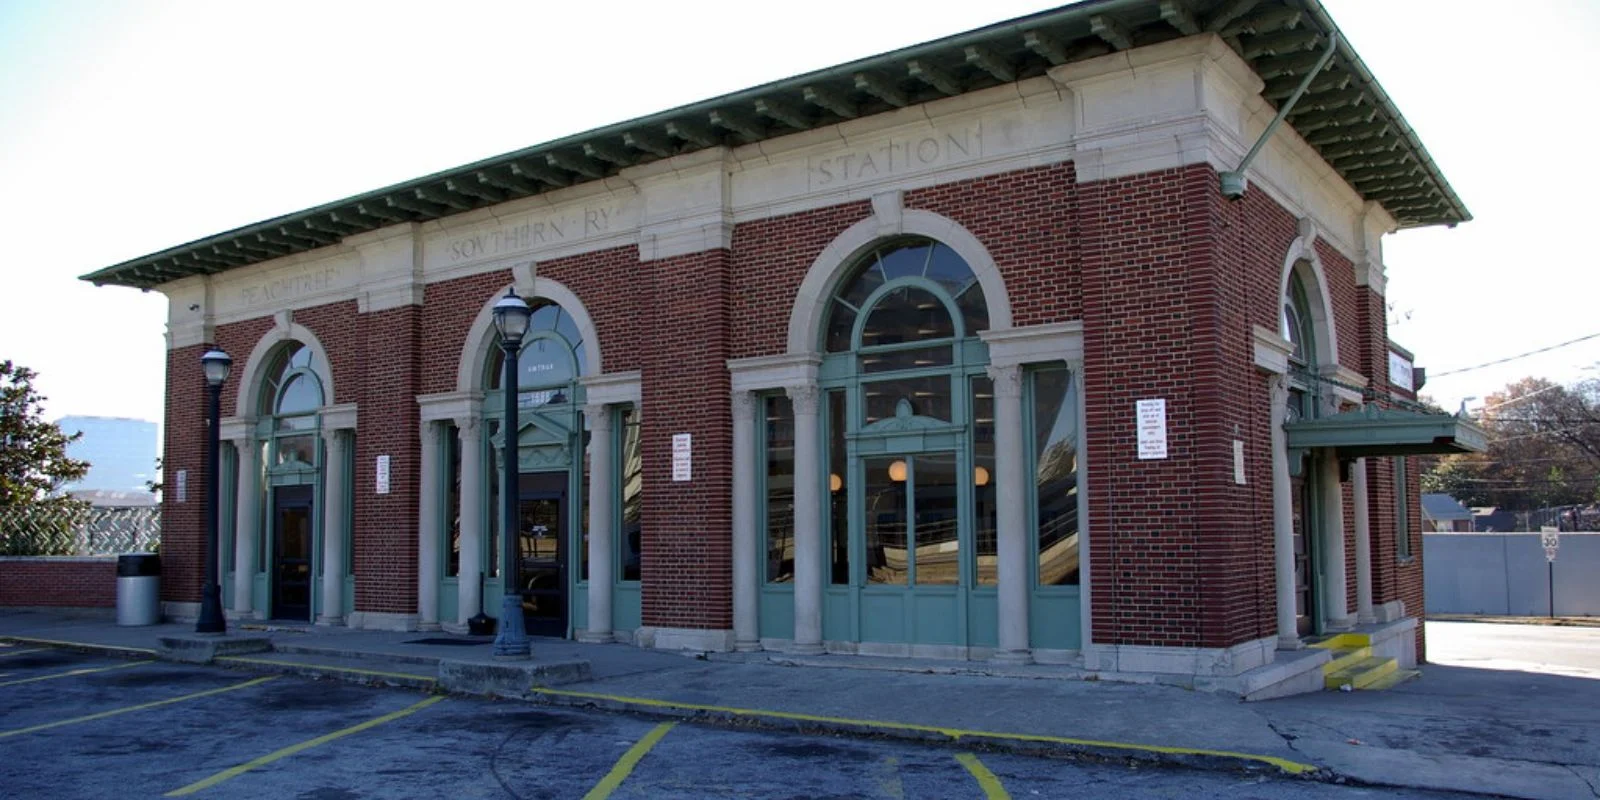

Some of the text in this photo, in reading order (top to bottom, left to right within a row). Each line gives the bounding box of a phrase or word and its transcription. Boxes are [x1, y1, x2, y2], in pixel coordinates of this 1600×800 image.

[819, 128, 970, 185] STATION
[242, 268, 336, 304] PEACHTREE
[1544, 538, 1557, 547] 30
